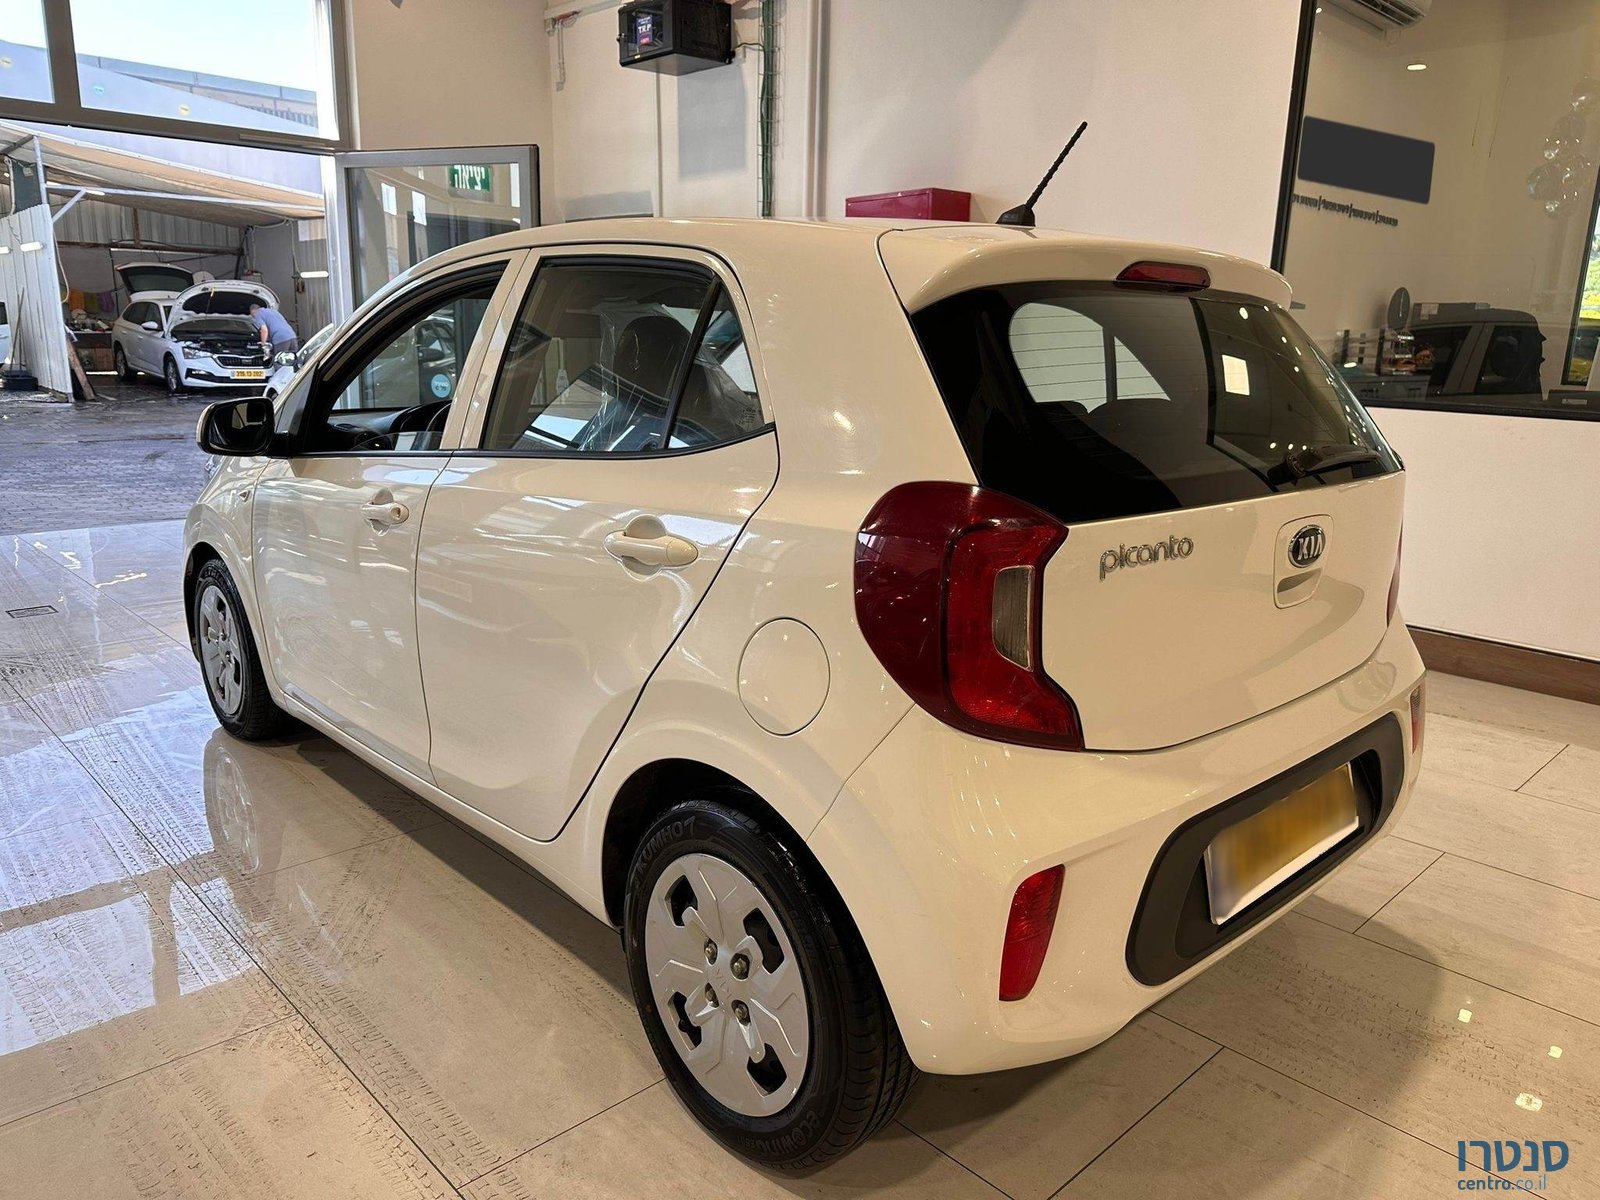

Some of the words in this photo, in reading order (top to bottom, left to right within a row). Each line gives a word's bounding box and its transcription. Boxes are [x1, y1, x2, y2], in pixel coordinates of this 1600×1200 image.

[453, 164, 486, 191] יציאה
[1099, 534, 1194, 581] picanto
[1297, 534, 1323, 561] KIA
